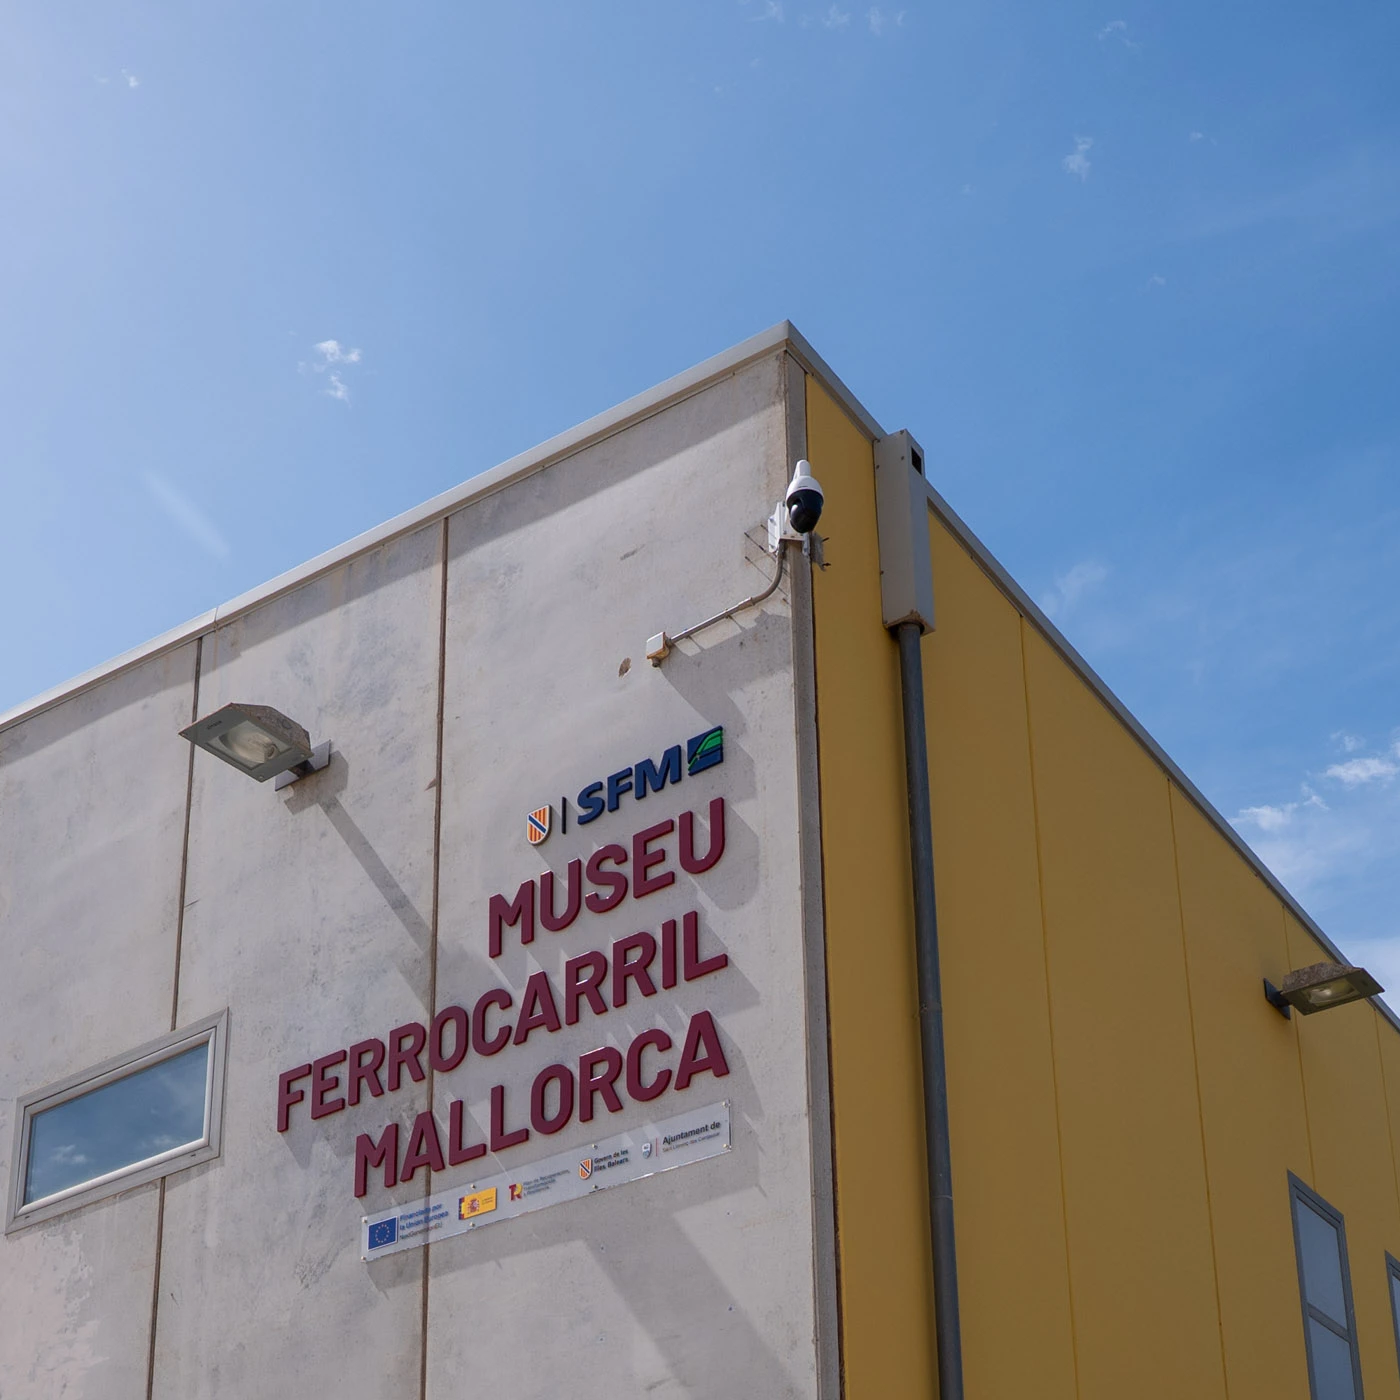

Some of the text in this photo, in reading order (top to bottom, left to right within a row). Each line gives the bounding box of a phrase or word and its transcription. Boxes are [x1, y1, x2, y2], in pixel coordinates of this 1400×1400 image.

[577, 744, 681, 825] SFM
[488, 796, 726, 958] MUSEU
[276, 910, 728, 1133] FERROCARRIL
[354, 1009, 730, 1198] MALLORCA
[662, 1121, 721, 1145] Ajuntament de
